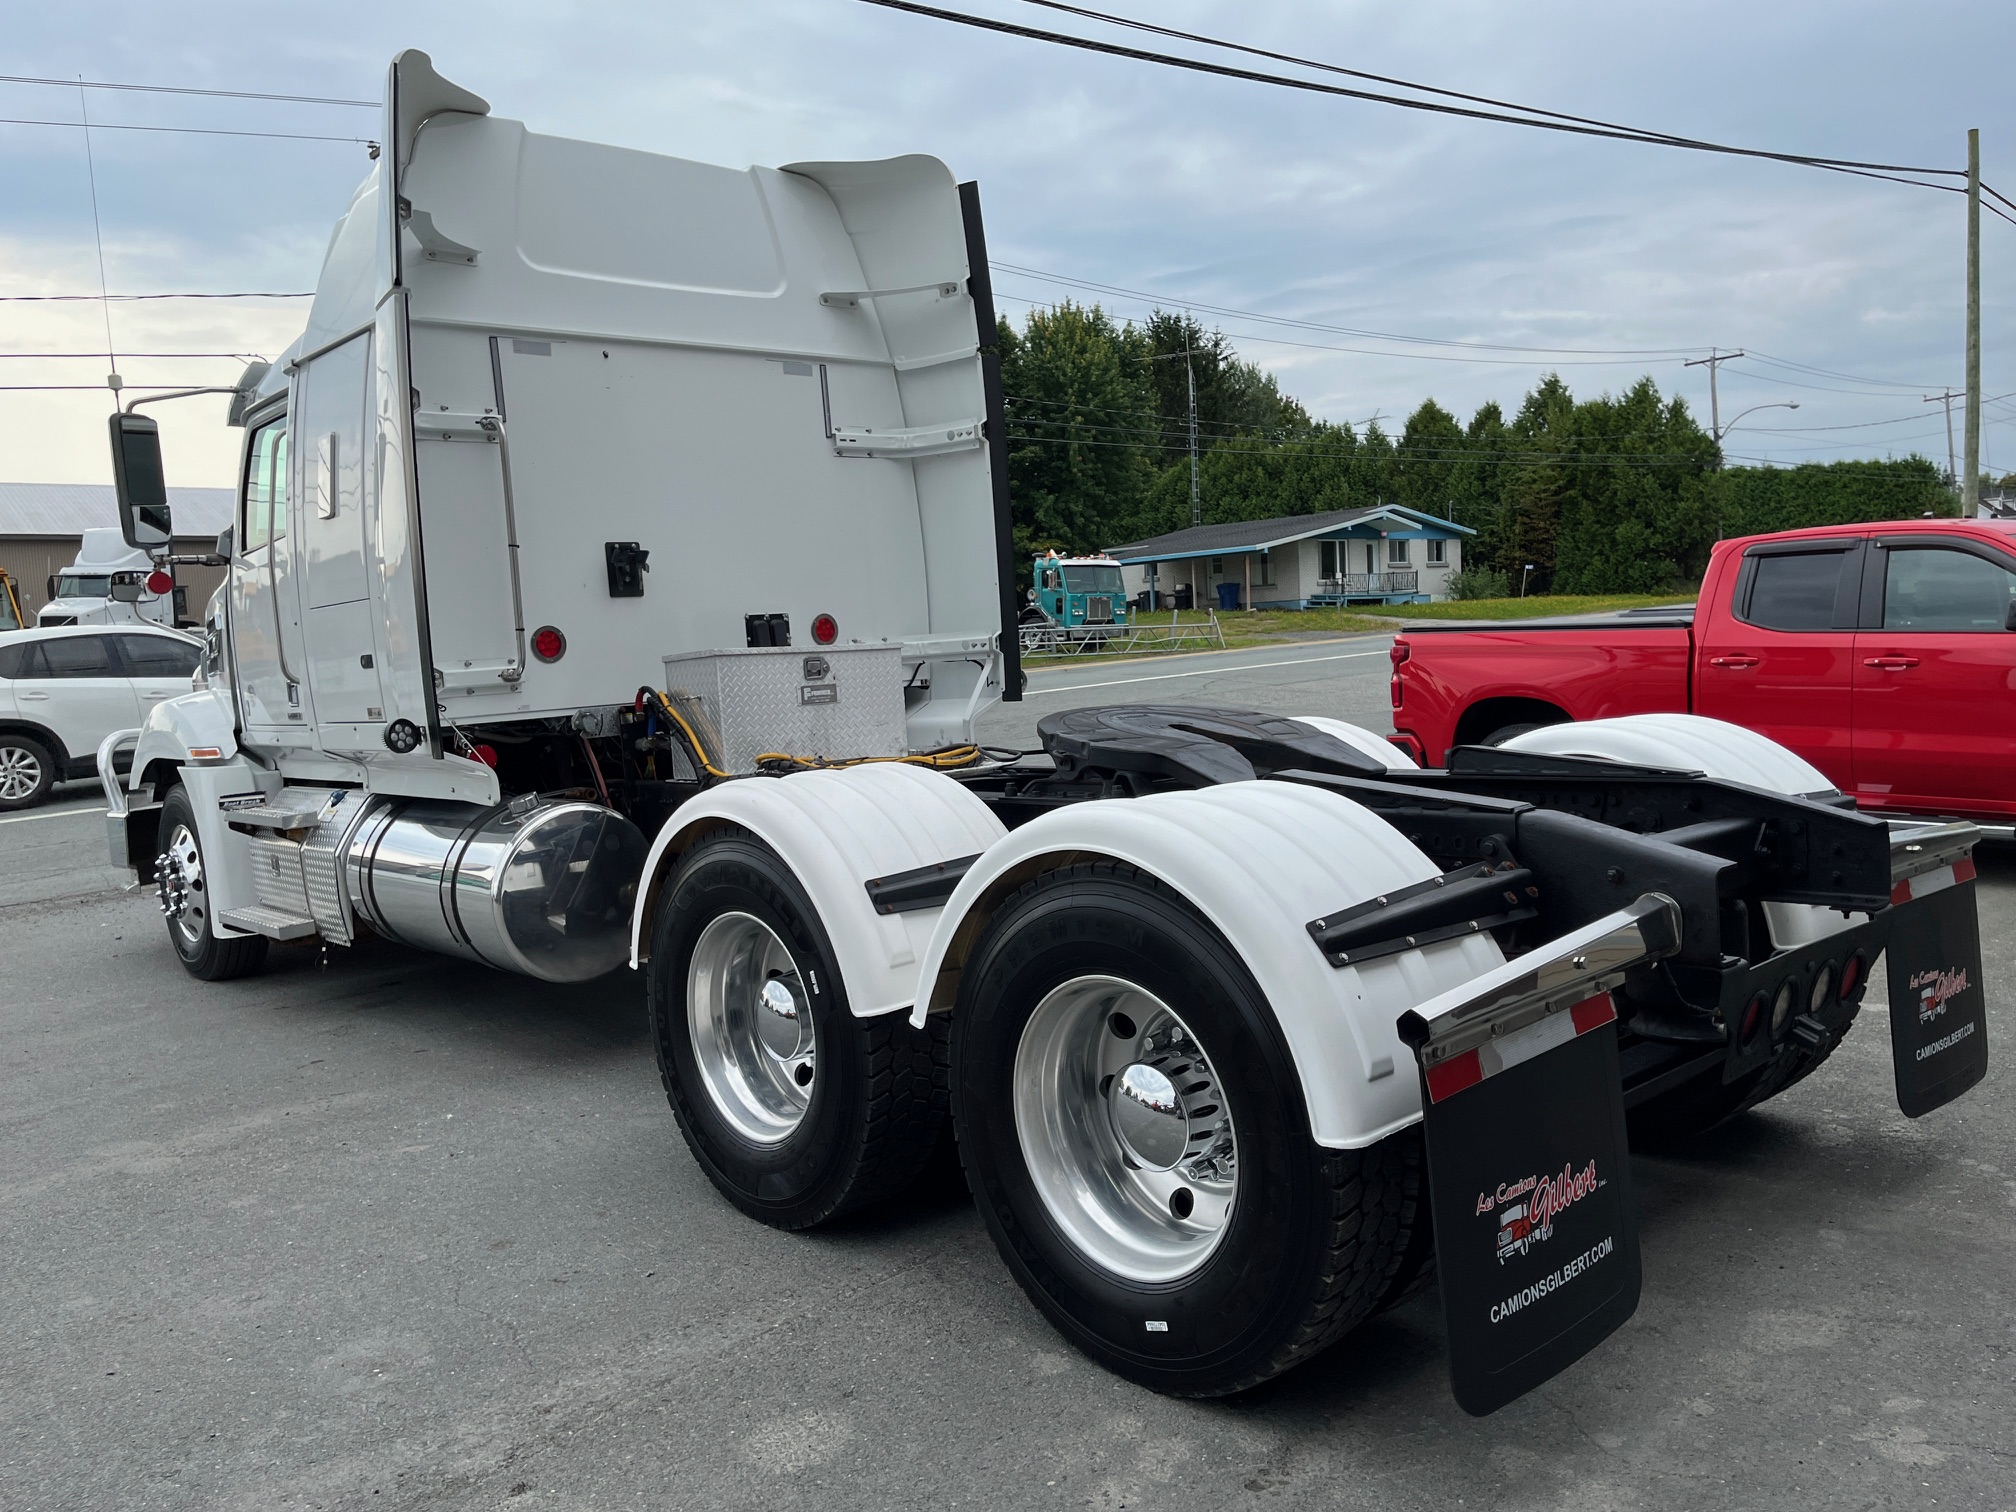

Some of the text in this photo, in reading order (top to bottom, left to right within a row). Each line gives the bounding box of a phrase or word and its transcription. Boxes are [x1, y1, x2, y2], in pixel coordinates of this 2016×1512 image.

[991, 914, 1144, 991] PREMIUM
[1934, 966, 1968, 1007] Gilbert
[1916, 1021, 1975, 1061] CAMIONSGILBERT.COM
[1476, 1192, 1495, 1217] Les
[1495, 1174, 1537, 1204] Camions
[1529, 1158, 1597, 1231] Gilbert
[1490, 1236, 1614, 1323] CAMIONSGILBERT.COM
